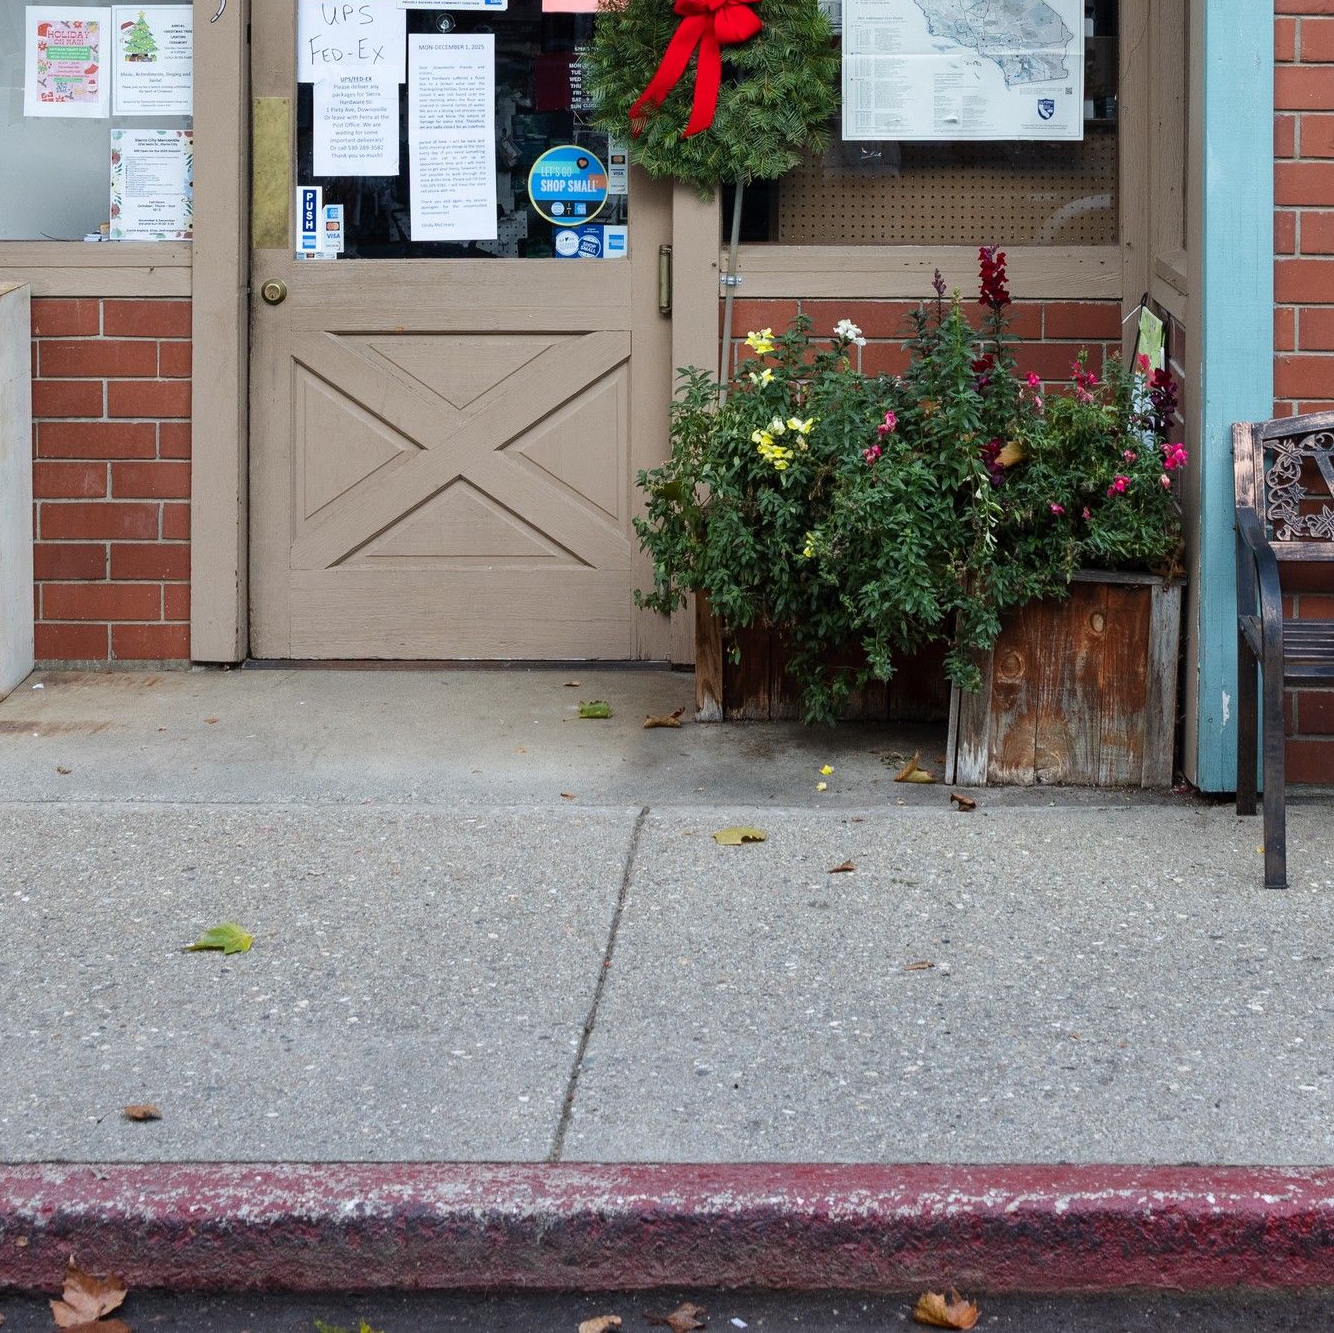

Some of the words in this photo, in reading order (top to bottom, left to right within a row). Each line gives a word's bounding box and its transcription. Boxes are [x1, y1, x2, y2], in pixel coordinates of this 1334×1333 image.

[322, 3, 374, 25] UPS
[541, 166, 561, 177] LET'S
[561, 166, 572, 177] GO
[540, 180, 566, 192] SHOP
[568, 180, 597, 192] SMALL
